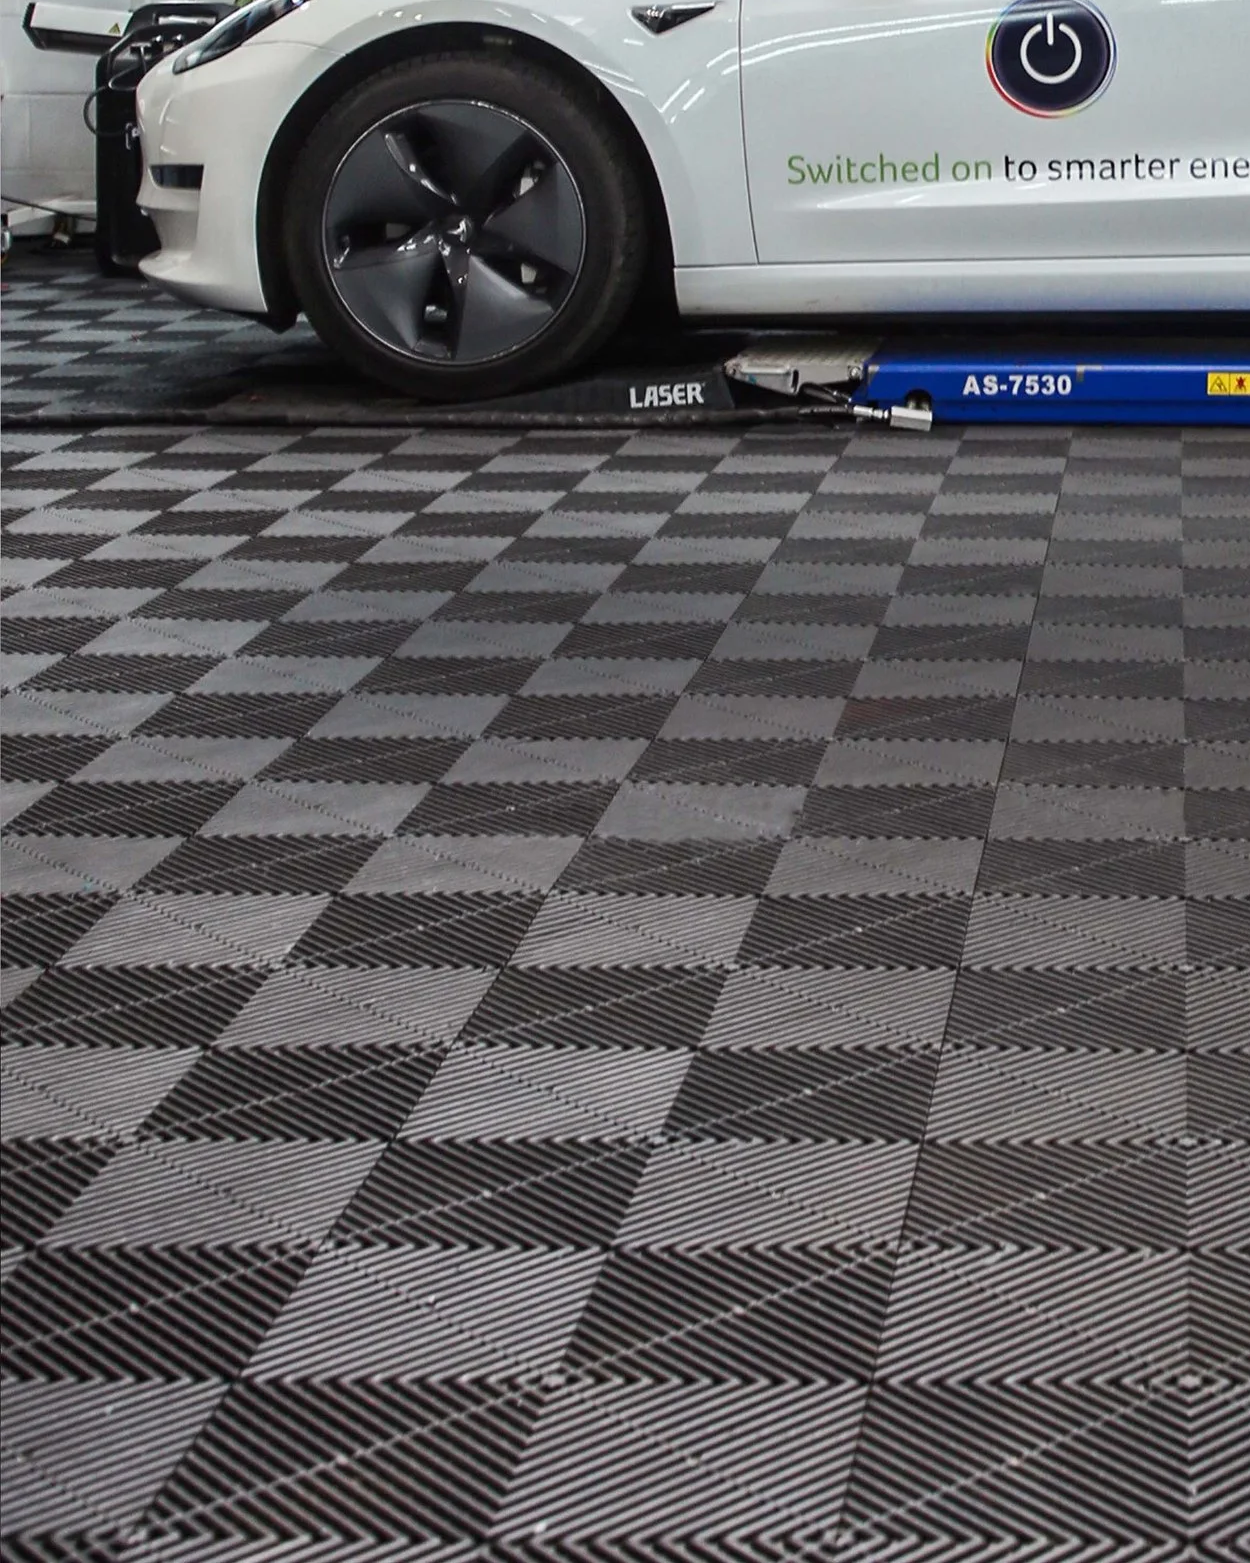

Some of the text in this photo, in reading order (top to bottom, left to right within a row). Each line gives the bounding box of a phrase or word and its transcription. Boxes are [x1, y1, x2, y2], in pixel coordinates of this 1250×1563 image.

[787, 152, 940, 185] Switched
[951, 159, 992, 182] on
[1004, 154, 1038, 182] to
[1048, 152, 1180, 180] smarter
[629, 382, 704, 409] LASER
[962, 374, 1072, 396] AS-7530
